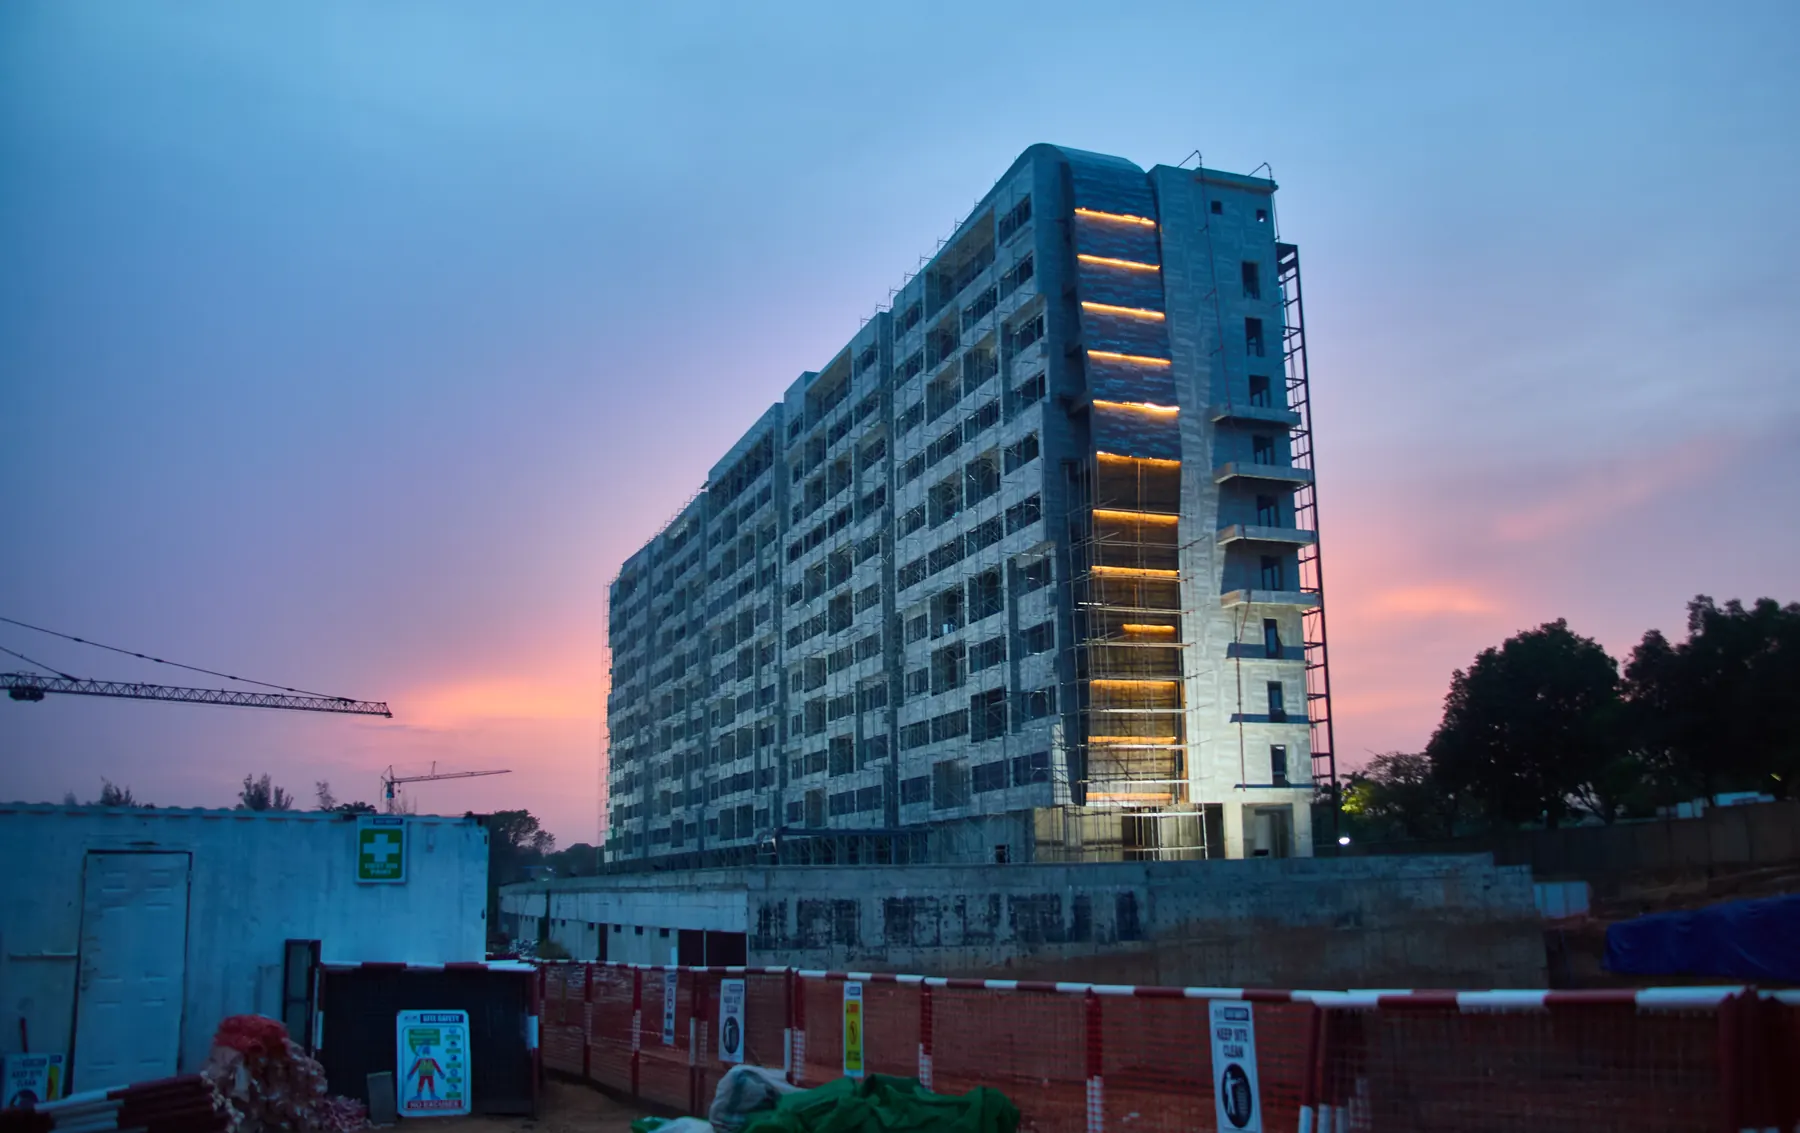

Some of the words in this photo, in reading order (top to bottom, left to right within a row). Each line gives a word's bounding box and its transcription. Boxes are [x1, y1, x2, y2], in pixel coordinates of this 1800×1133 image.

[437, 1014, 460, 1022] SAFETY
[1216, 1027, 1233, 1041] KEEP
[1234, 1028, 1248, 1042] SITE
[1223, 1044, 1244, 1058] CLEAN
